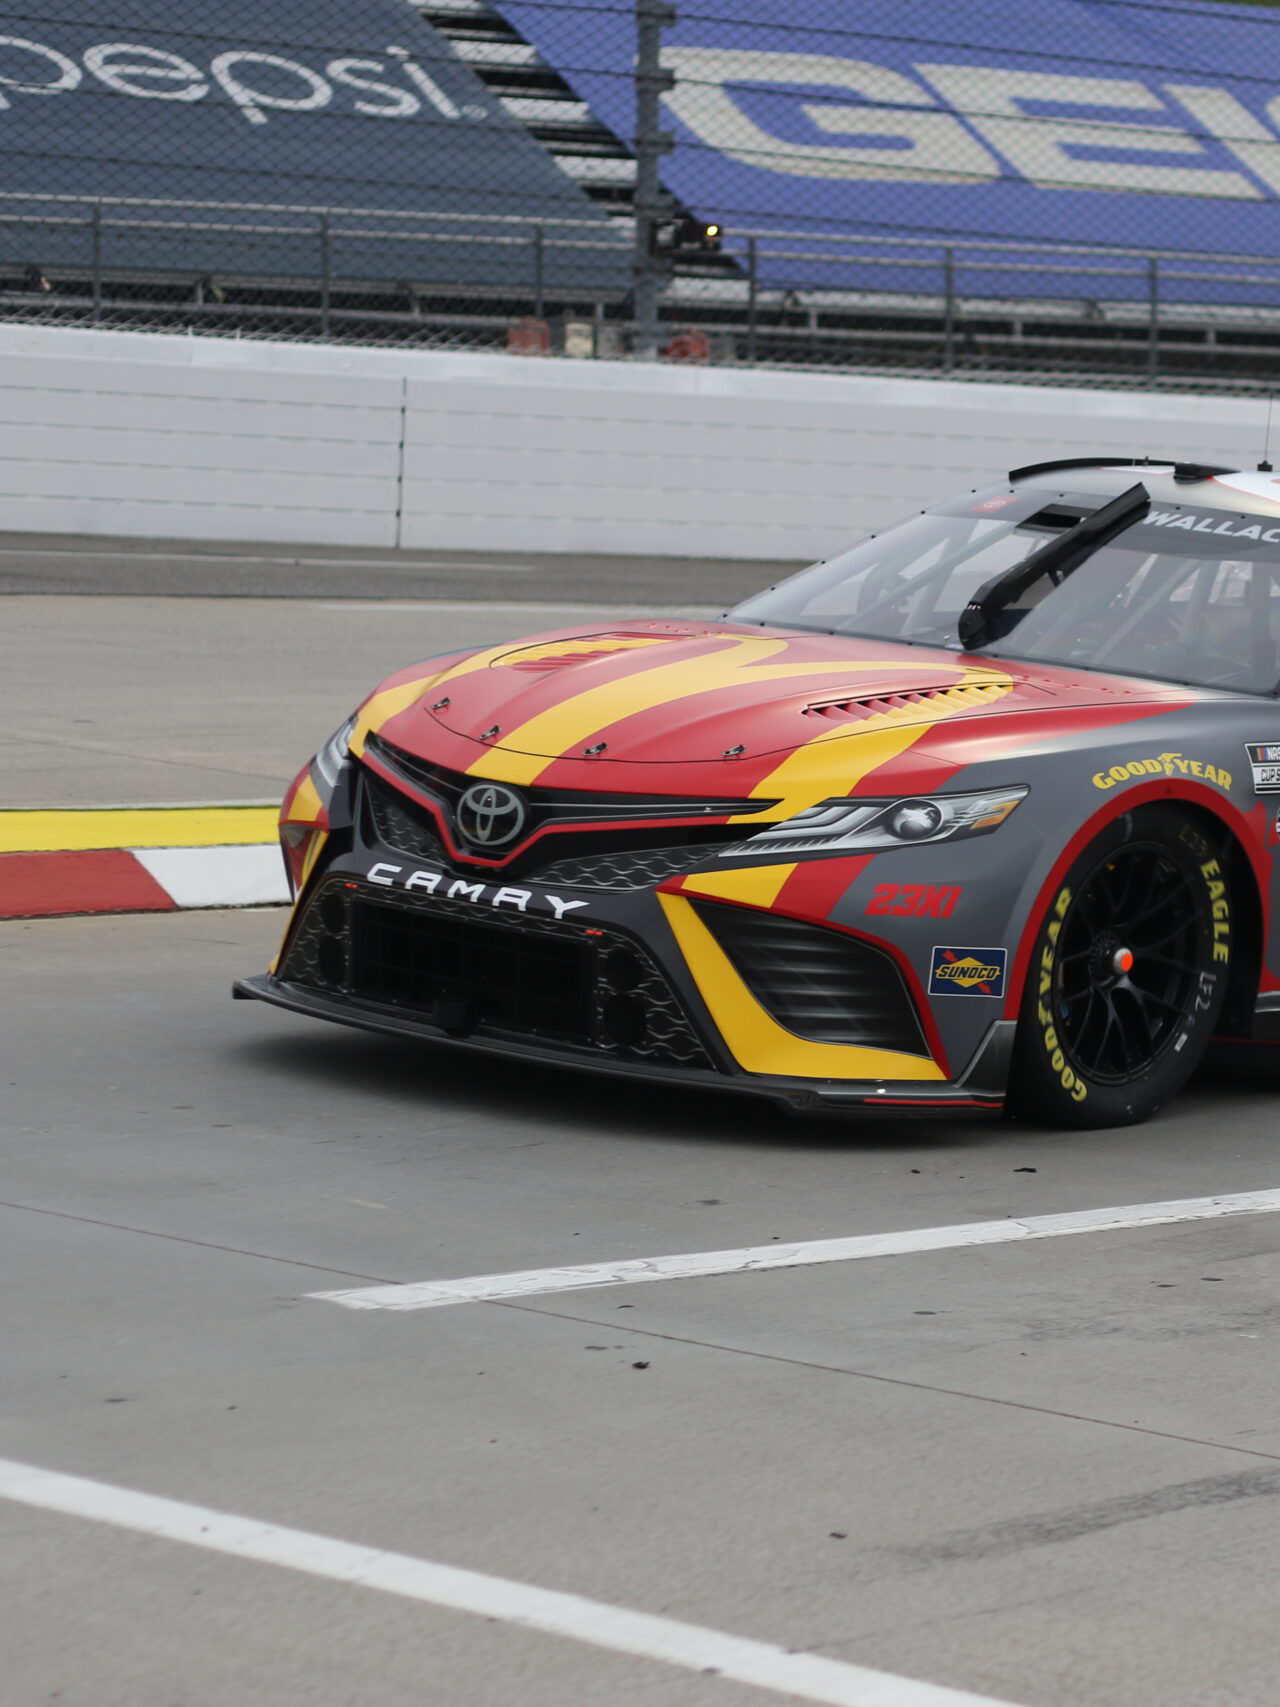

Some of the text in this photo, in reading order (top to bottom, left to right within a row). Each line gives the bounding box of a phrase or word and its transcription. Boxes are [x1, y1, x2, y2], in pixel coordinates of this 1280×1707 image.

[0, 35, 462, 125] pepsi
[1261, 768, 1276, 782] CUP
[366, 862, 590, 920] CAMRY
[863, 883, 964, 919] 23XI
[1200, 857, 1230, 964] EAGLE
[938, 965, 1000, 979] SUNOCO
